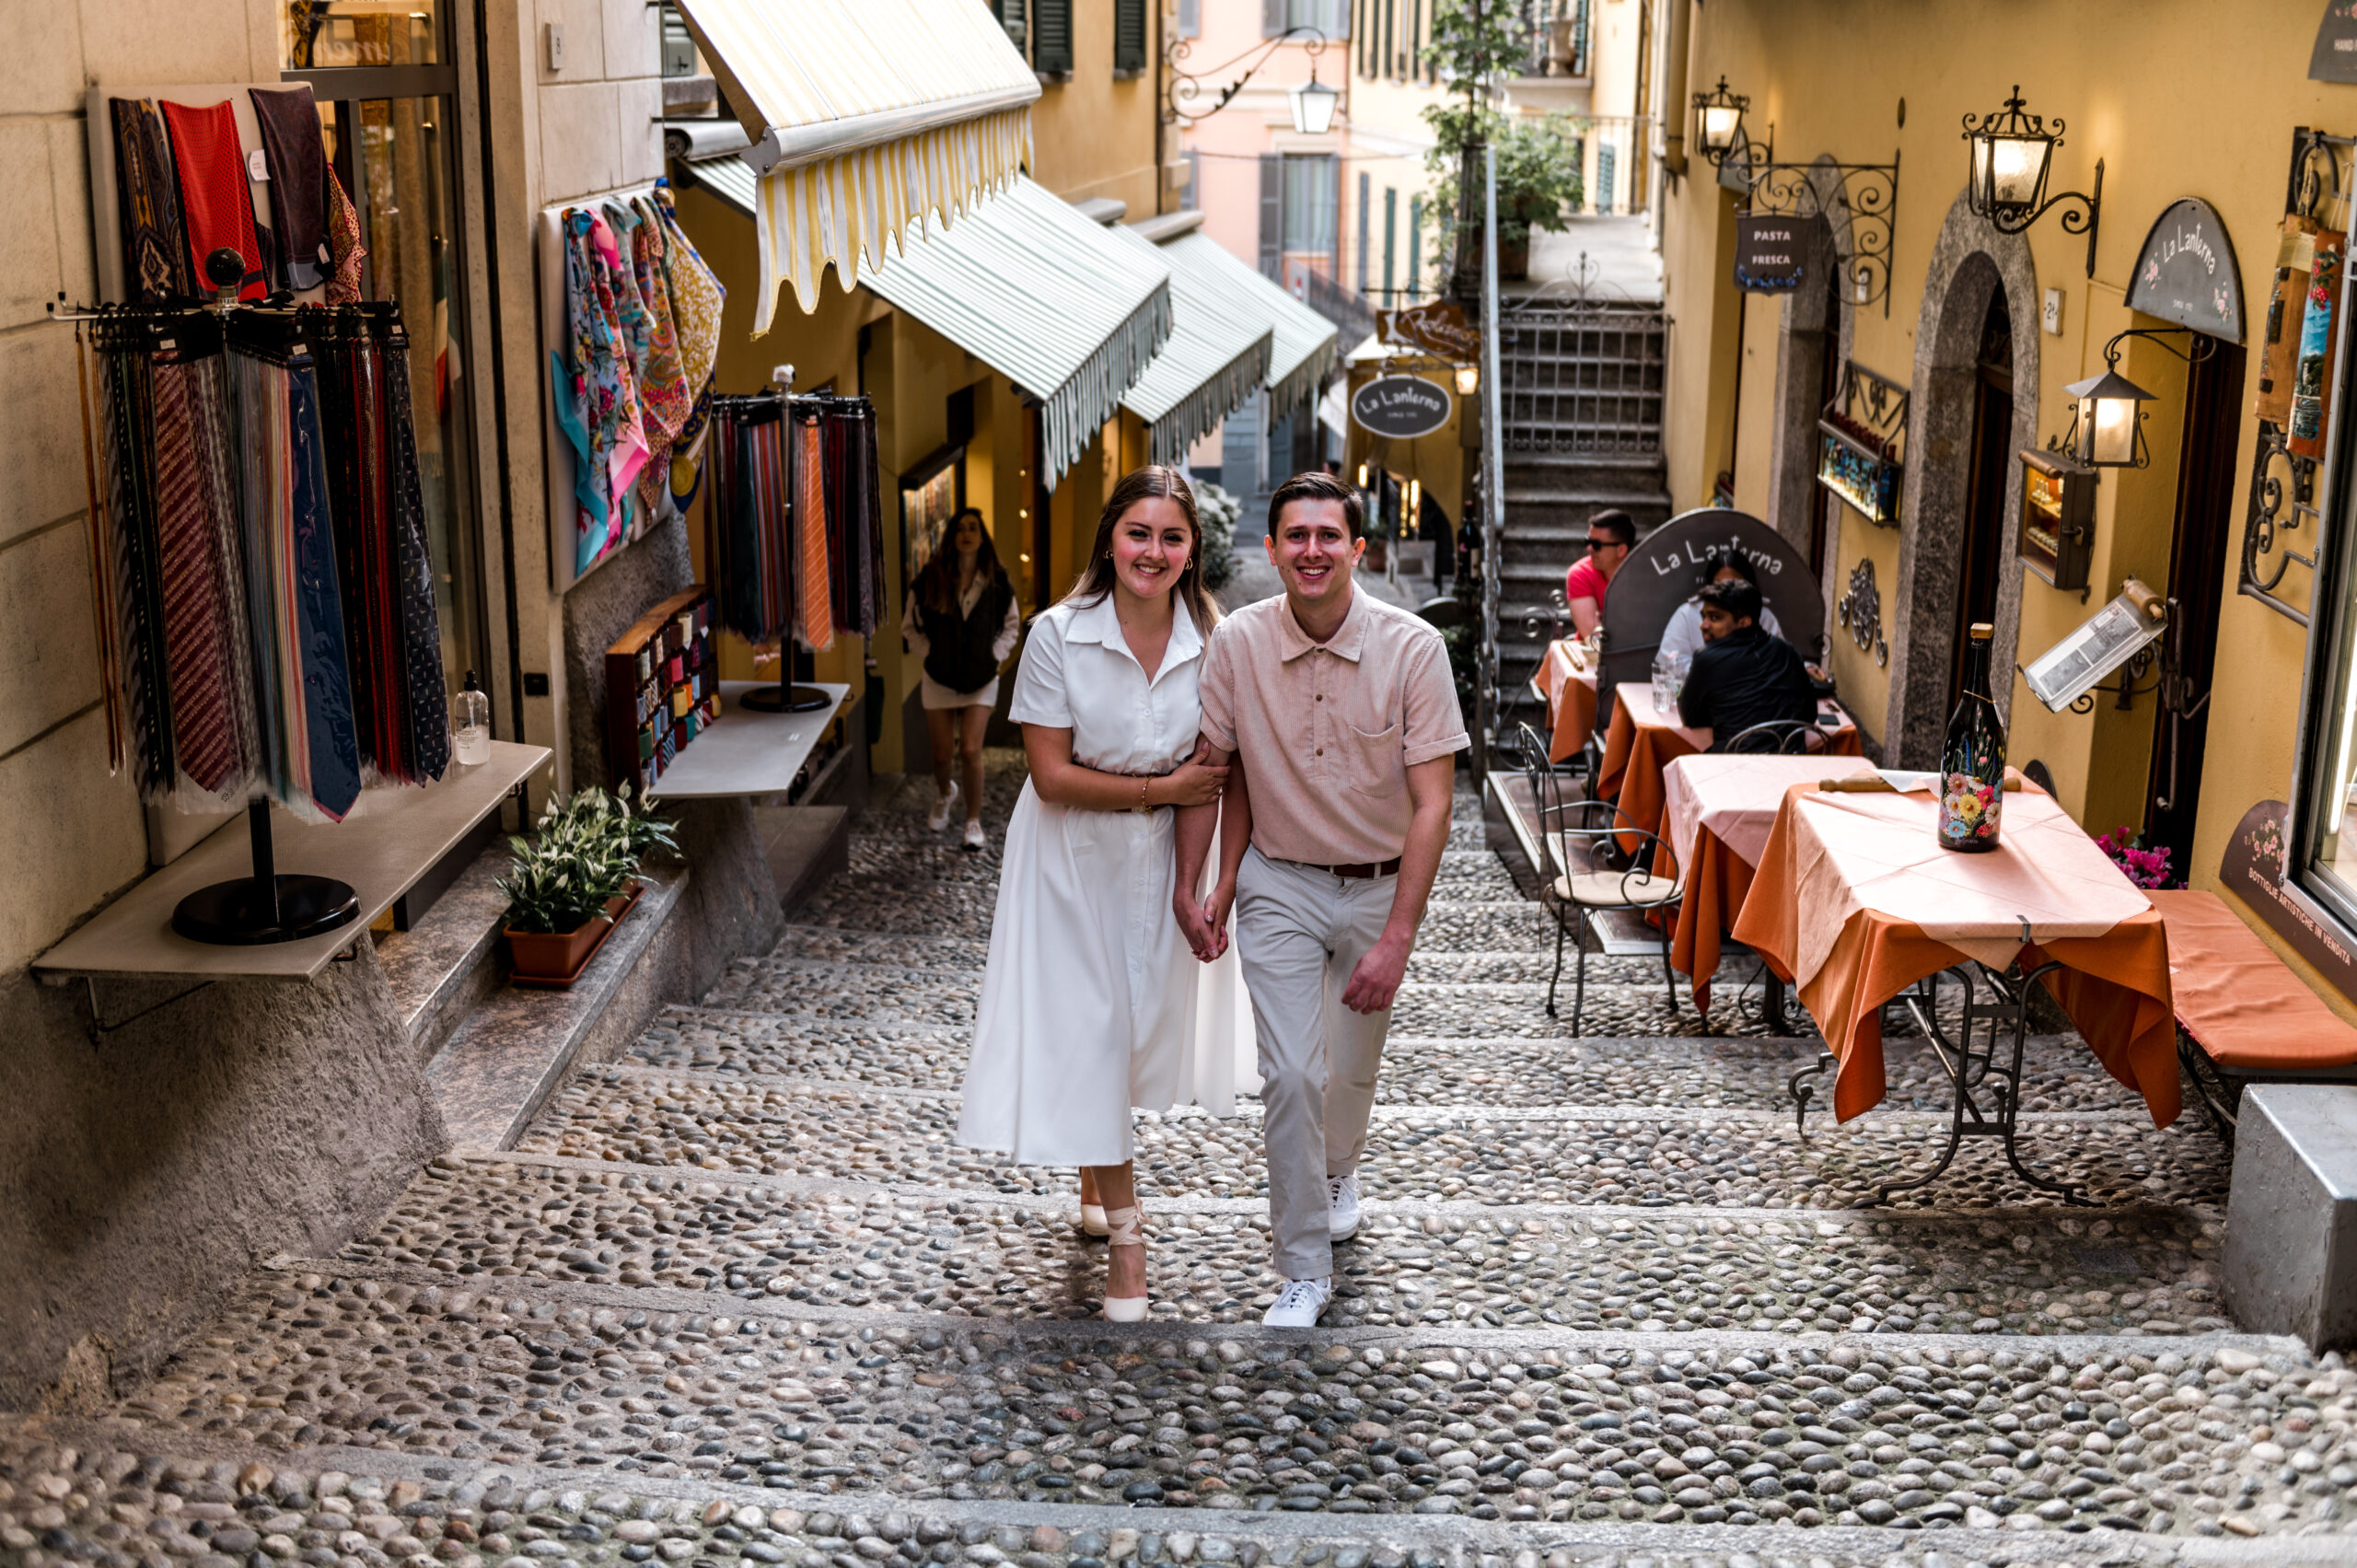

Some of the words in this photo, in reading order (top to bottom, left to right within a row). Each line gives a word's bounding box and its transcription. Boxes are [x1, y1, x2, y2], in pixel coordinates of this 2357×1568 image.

[556, 37, 561, 55] 8
[1754, 231, 1791, 241] PASTA
[1752, 255, 1791, 265] FRESCA
[2163, 240, 2176, 263] La
[2177, 223, 2216, 275] Lanterna
[1360, 401, 1379, 413] La
[1380, 387, 1441, 412] Lanterna
[1651, 554, 1680, 576] La
[2248, 867, 2279, 900] BOTTIGLIE
[2279, 893, 2315, 932] ARTISTICHE
[2315, 922, 2322, 939] IN
[2323, 932, 2351, 967] VENDITA
